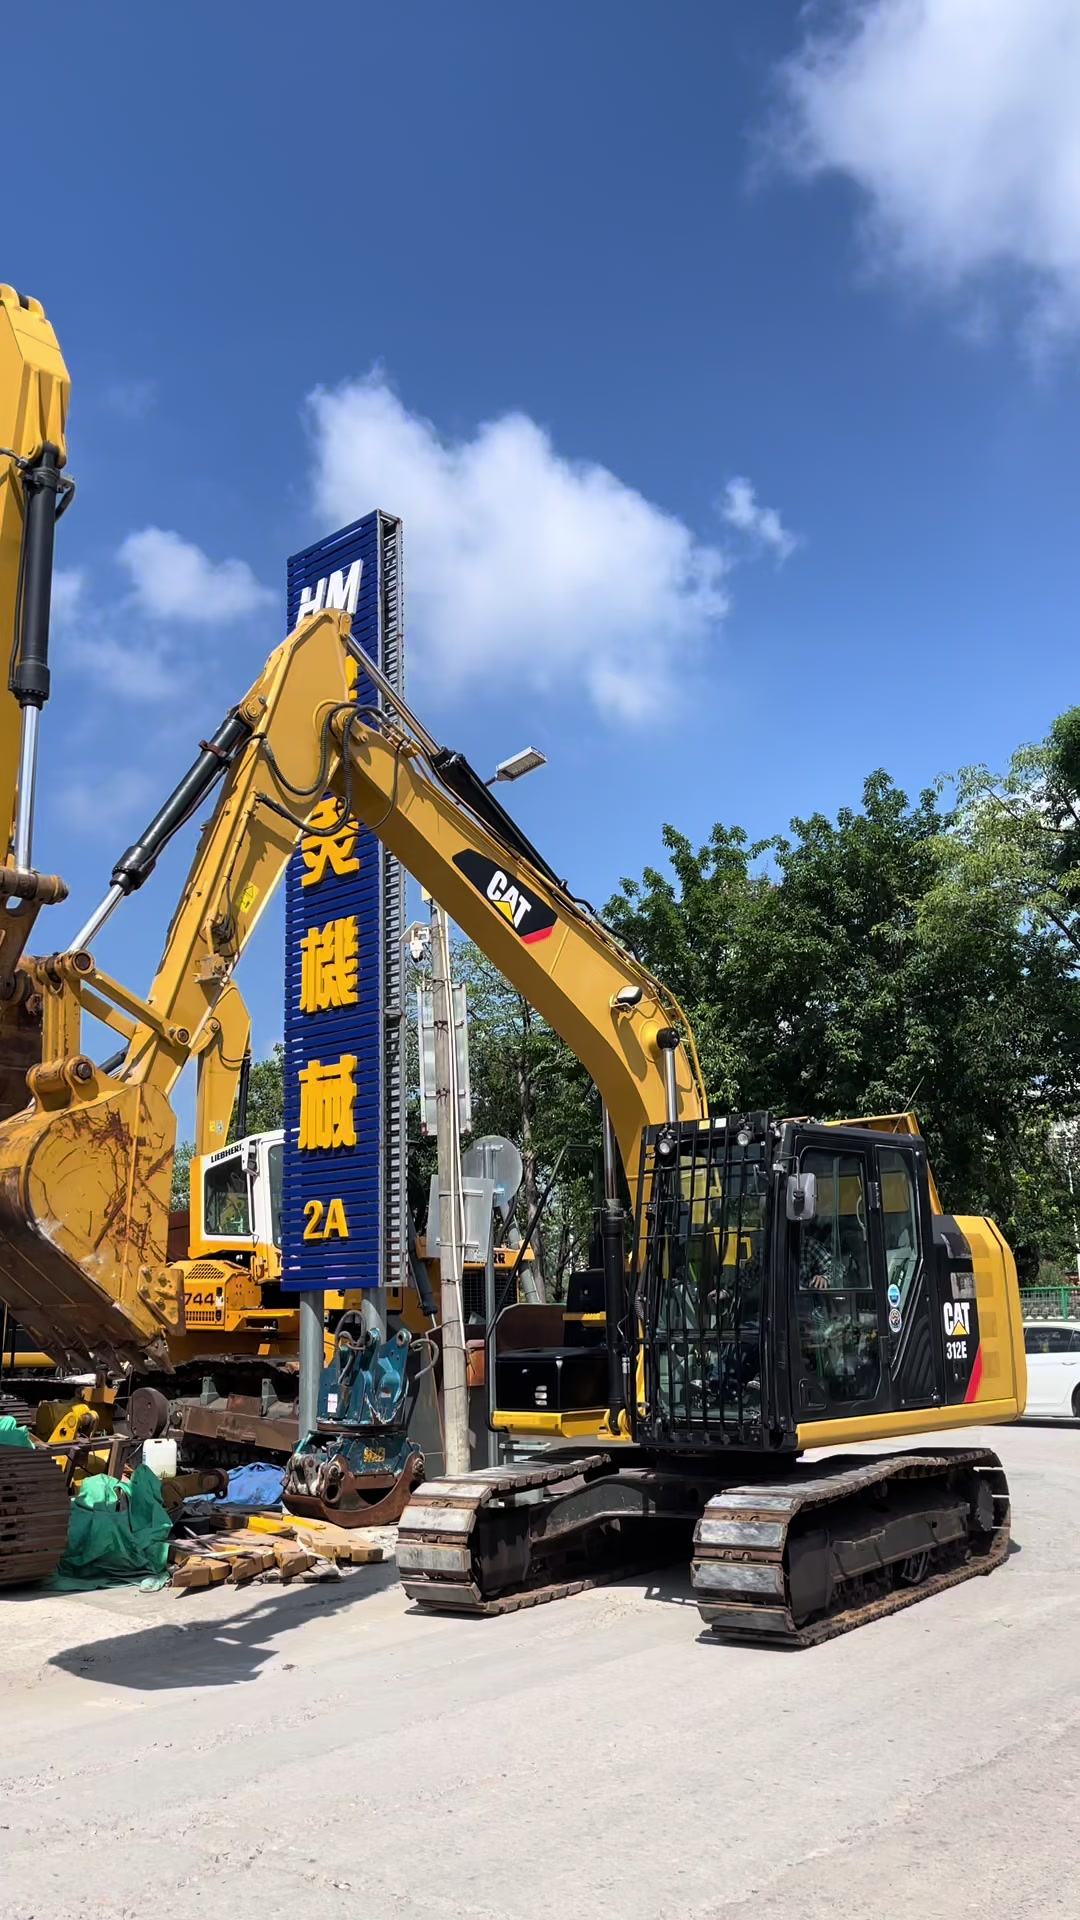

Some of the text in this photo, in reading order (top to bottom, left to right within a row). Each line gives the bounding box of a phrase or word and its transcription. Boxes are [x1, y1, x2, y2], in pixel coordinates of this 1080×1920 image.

[296, 558, 364, 627] HM
[298, 655, 360, 1150] 美機械
[486, 870, 532, 928] CAT
[303, 1198, 349, 1240] 2A
[943, 1302, 970, 1335] CAT
[946, 1341, 967, 1359] 312E
